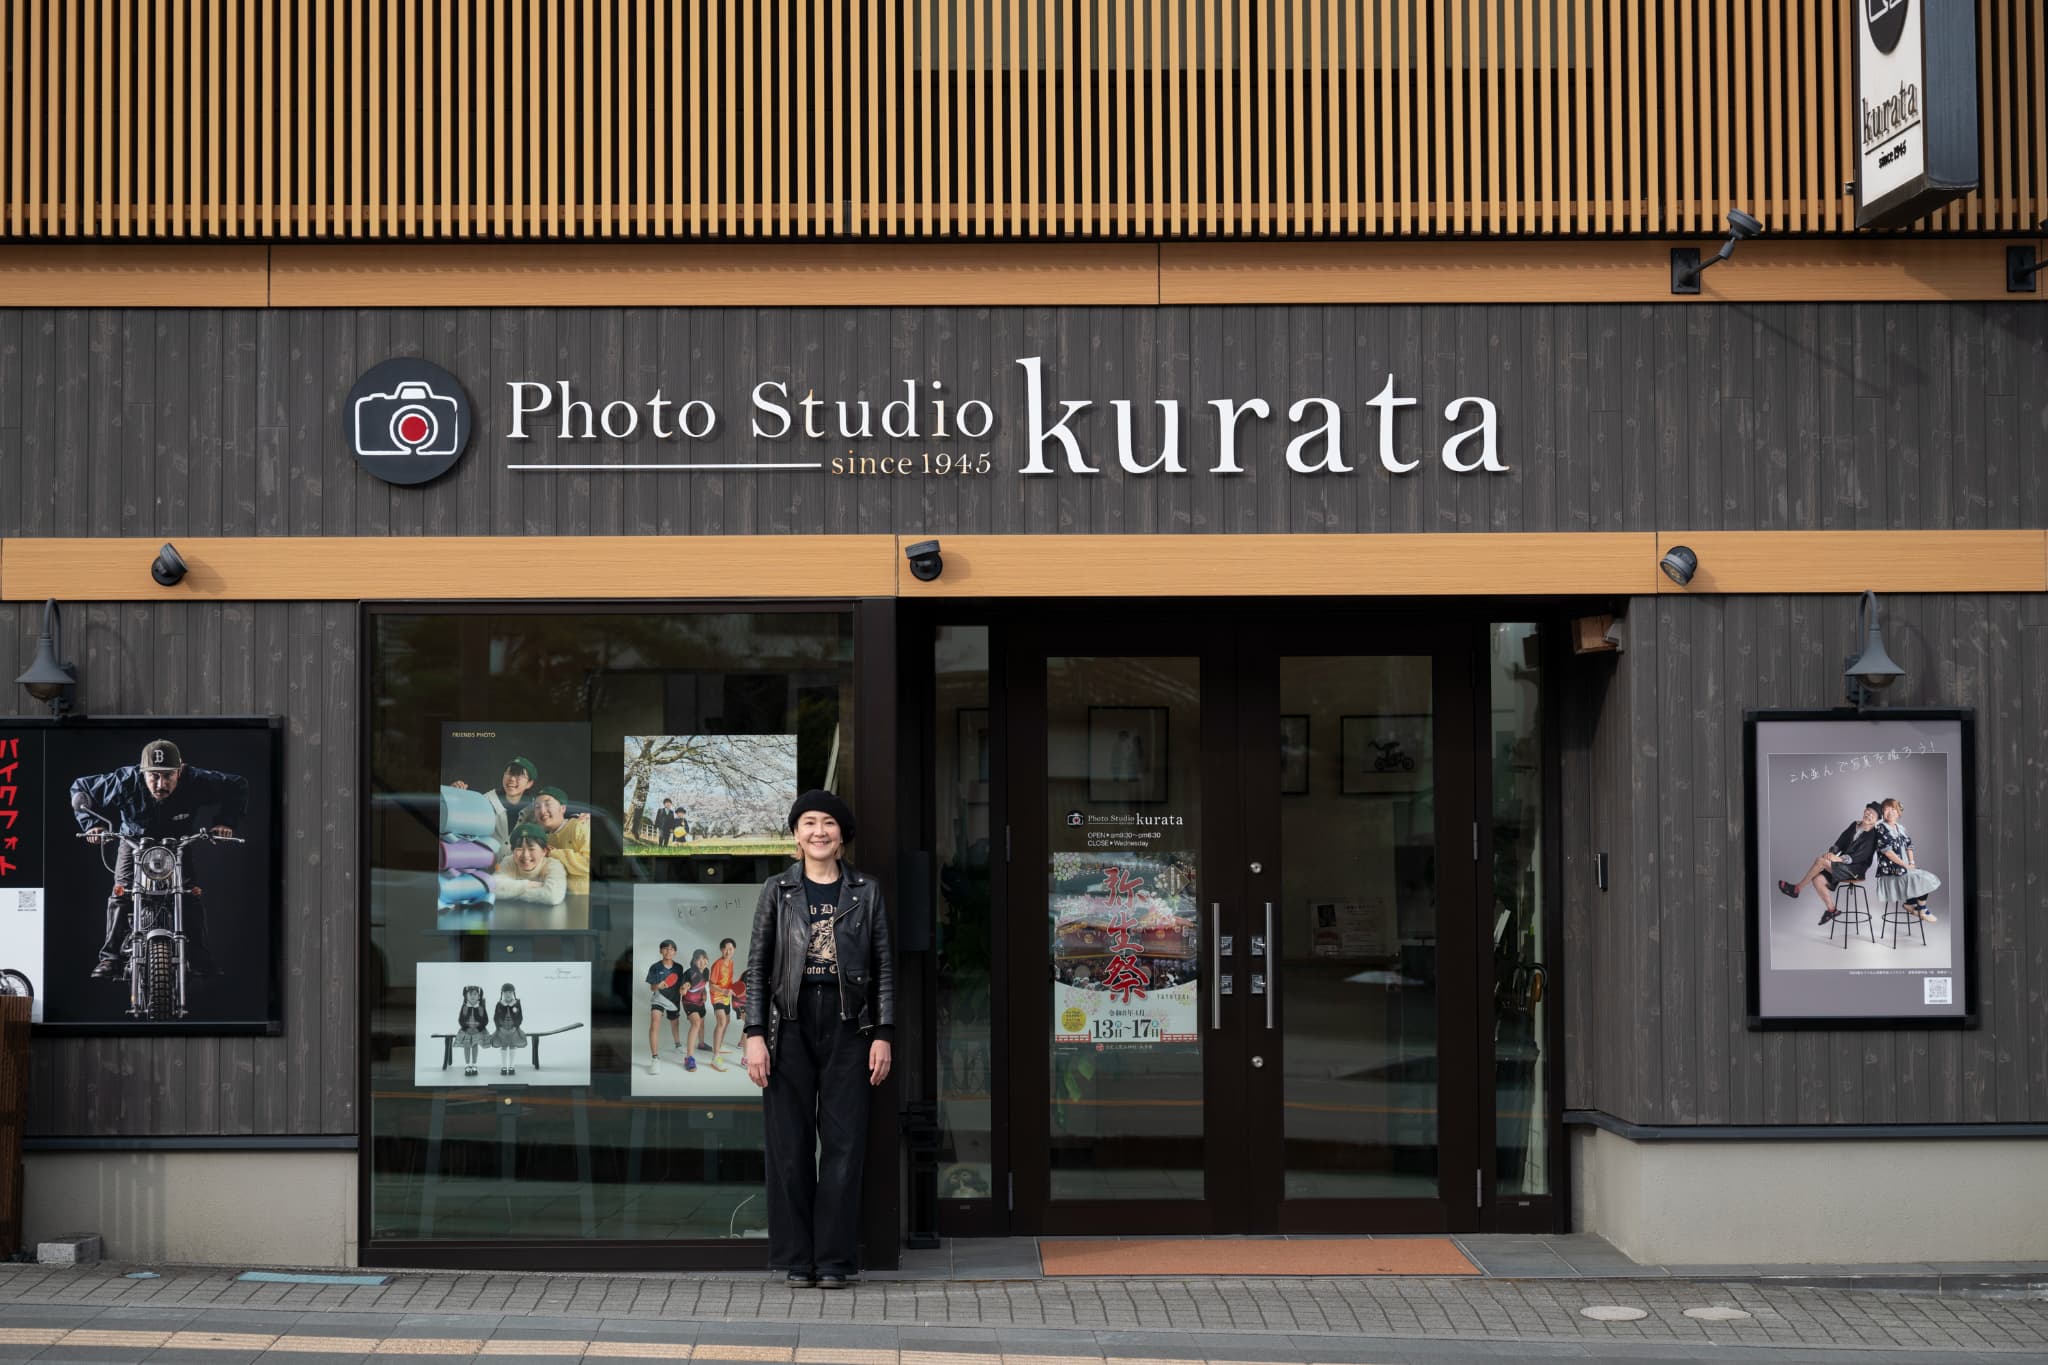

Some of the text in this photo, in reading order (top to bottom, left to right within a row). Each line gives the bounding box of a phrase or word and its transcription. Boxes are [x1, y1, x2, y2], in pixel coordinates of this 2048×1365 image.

[1862, 80, 1918, 145] kurata
[506, 356, 1510, 475] Photo Studio kurata
[831, 449, 993, 475] since 1945
[154, 749, 164, 763] B
[1136, 813, 1184, 825] kurata
[1114, 840, 1149, 848] Wednesday
[1103, 867, 1150, 1003] 弥生祭
